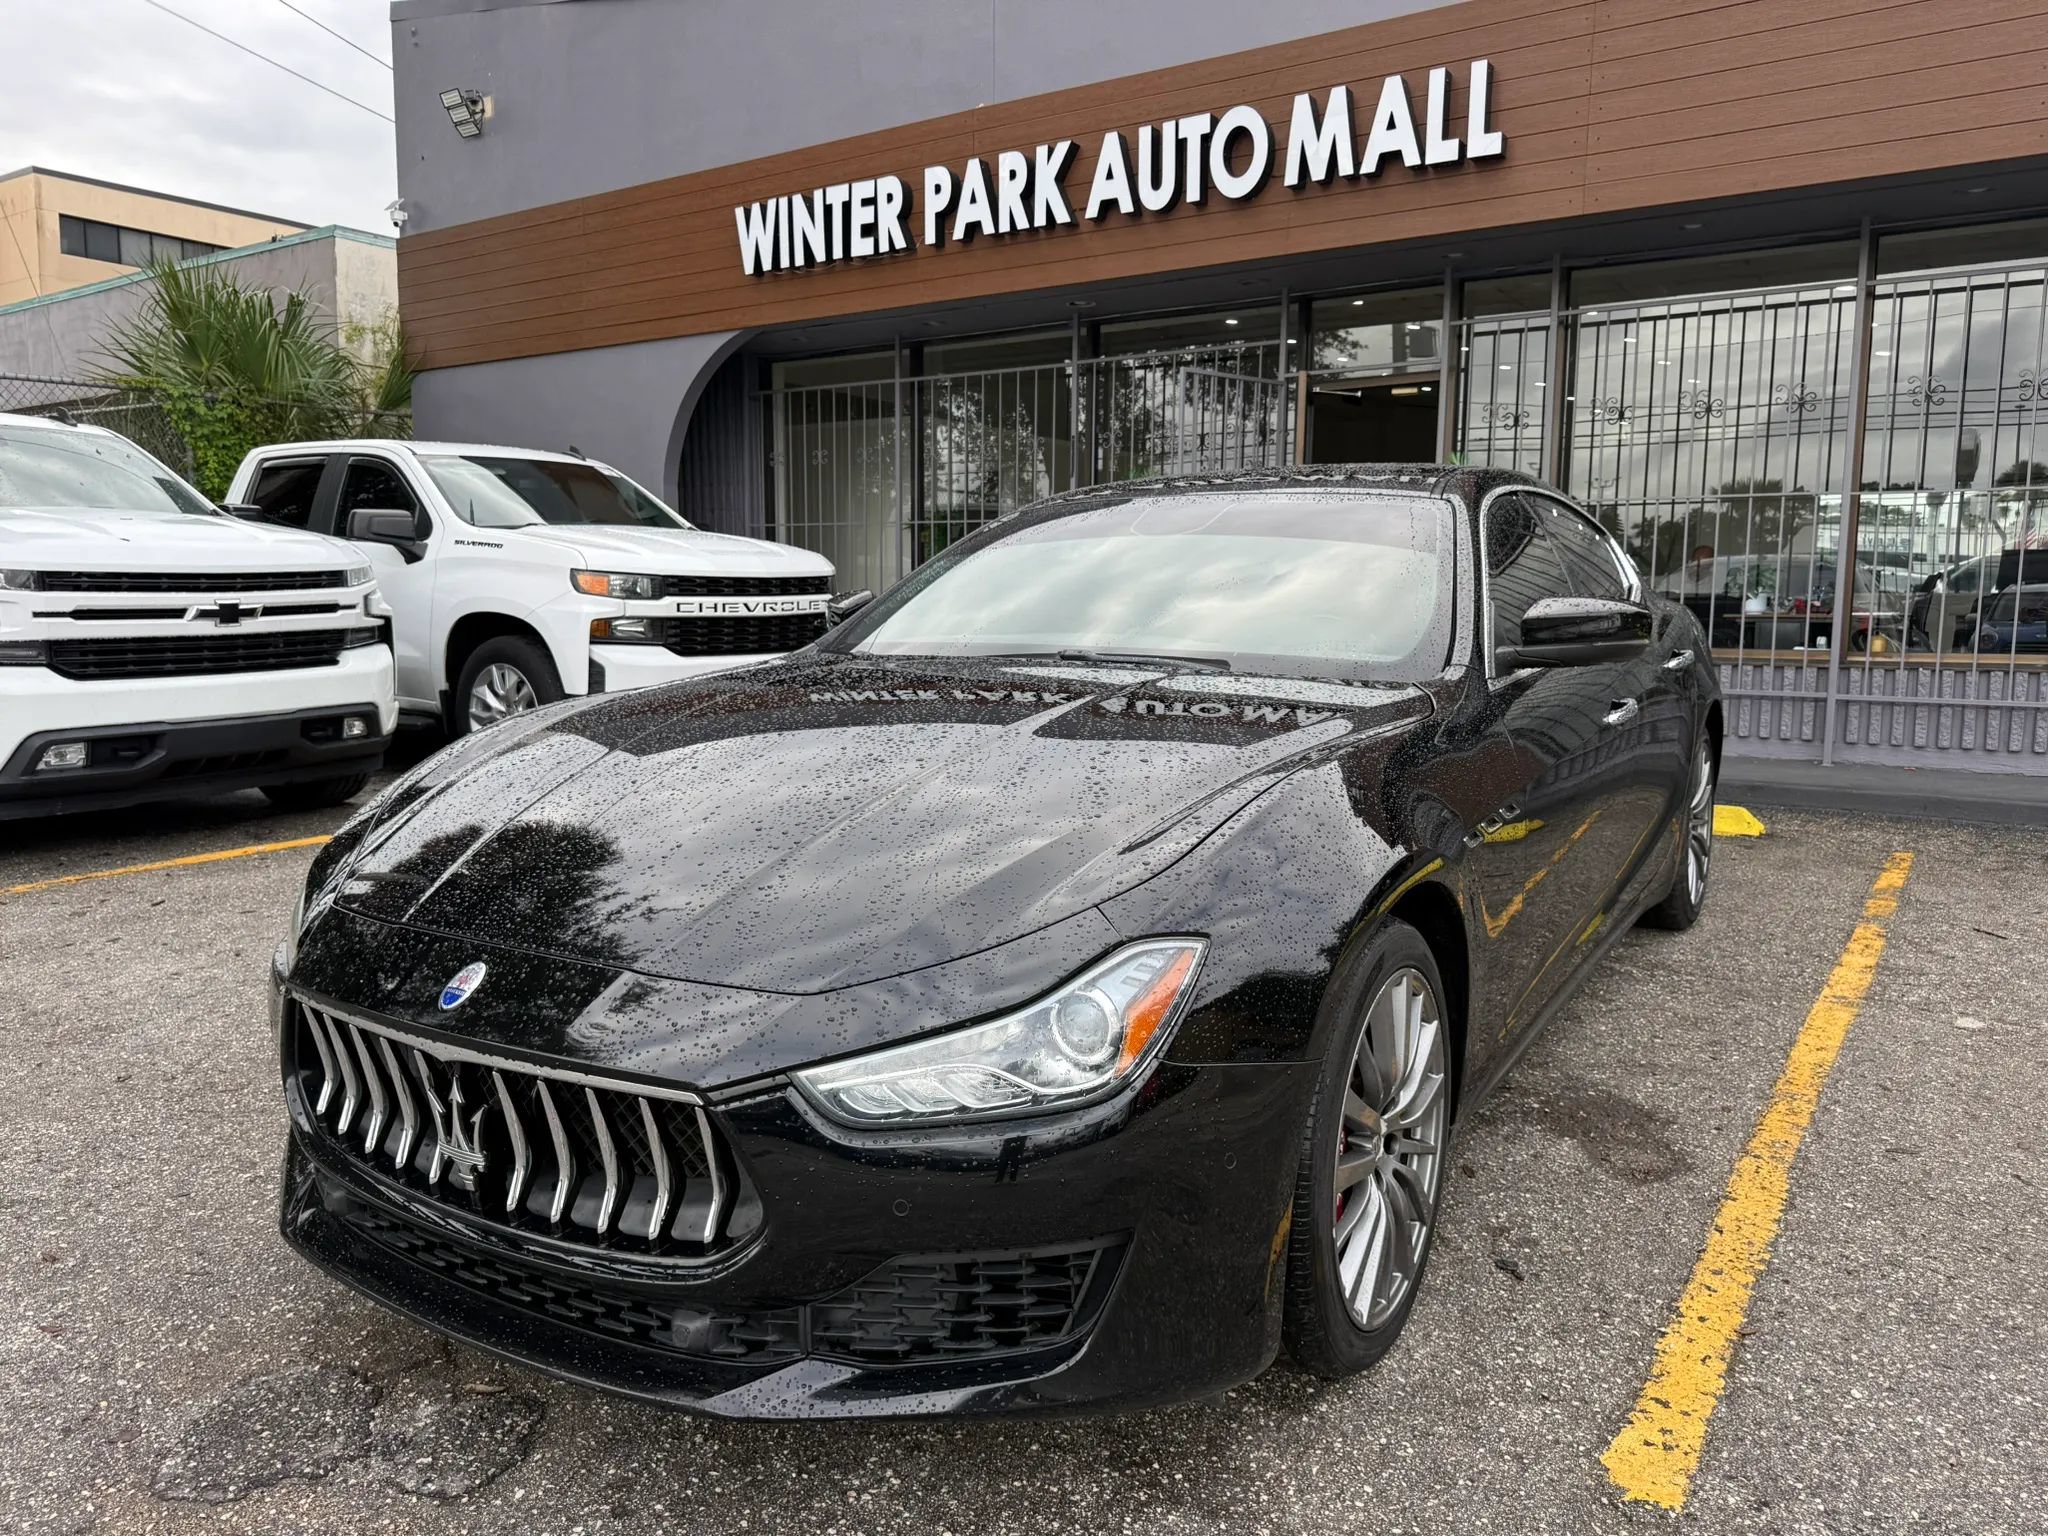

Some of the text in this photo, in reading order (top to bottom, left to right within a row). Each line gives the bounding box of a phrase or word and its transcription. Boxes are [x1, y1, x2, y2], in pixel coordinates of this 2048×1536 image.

[735, 59, 1504, 275] WINTER PARK AUTO MALL
